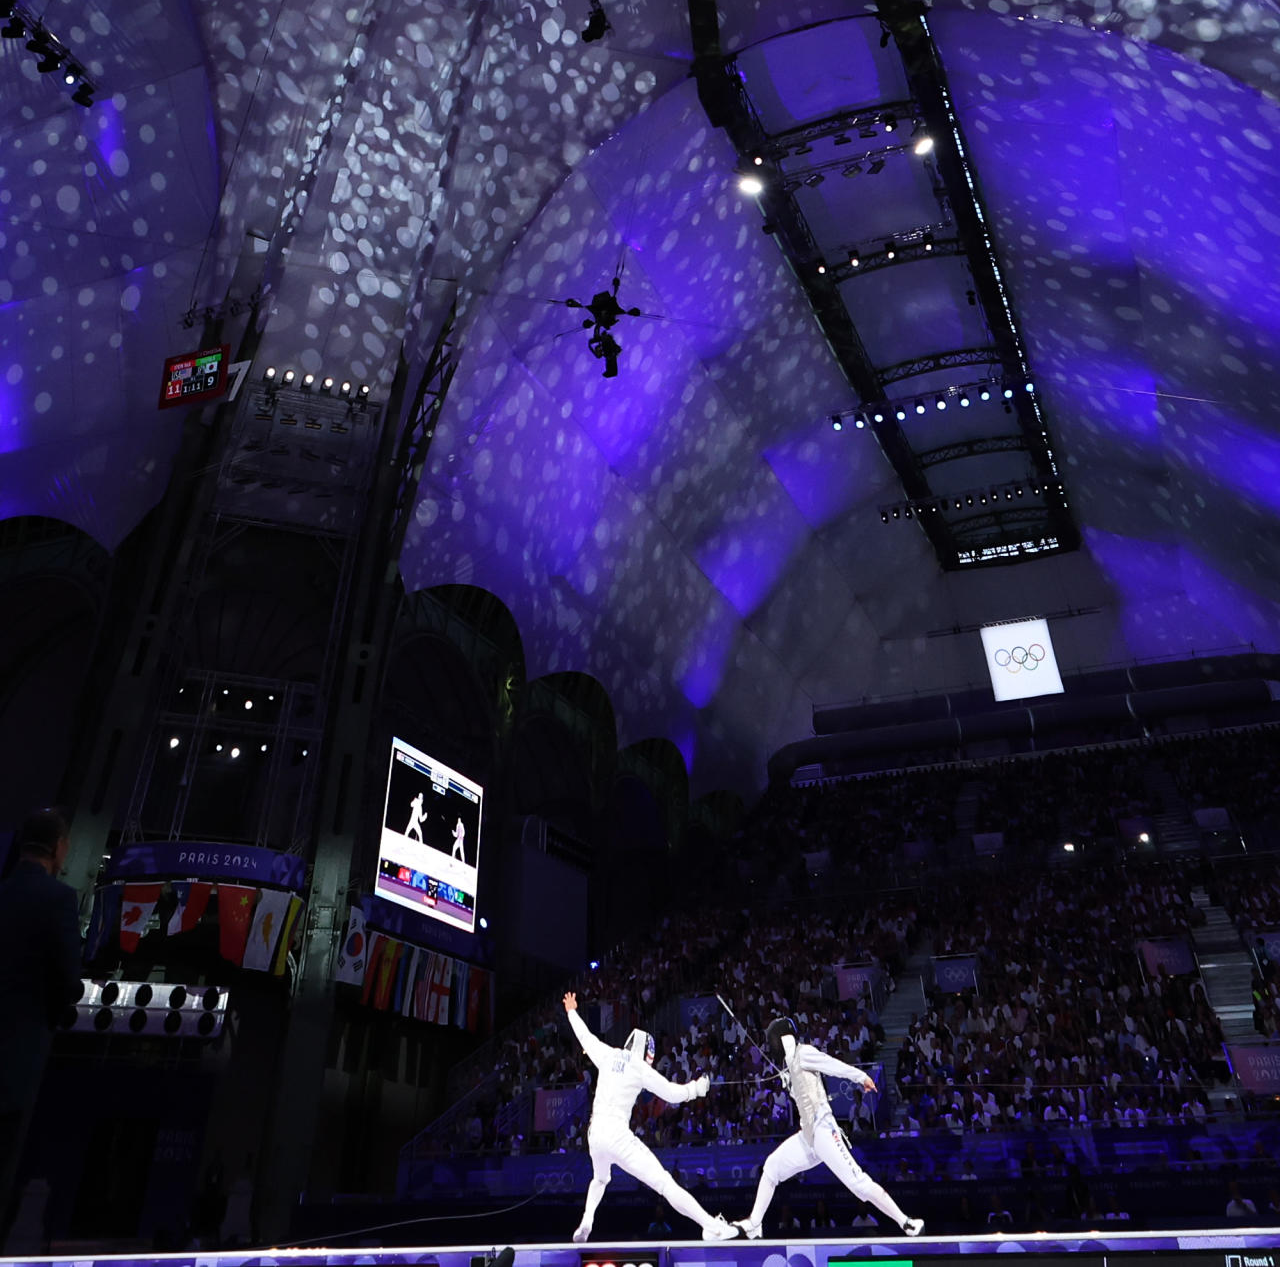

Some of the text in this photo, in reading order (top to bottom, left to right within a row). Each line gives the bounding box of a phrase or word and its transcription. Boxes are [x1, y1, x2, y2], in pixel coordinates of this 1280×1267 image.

[207, 376, 215, 386] 9
[168, 384, 180, 395] 11
[178, 851, 258, 869] PARIS 2024
[1243, 1255, 1275, 1267] Round 1
